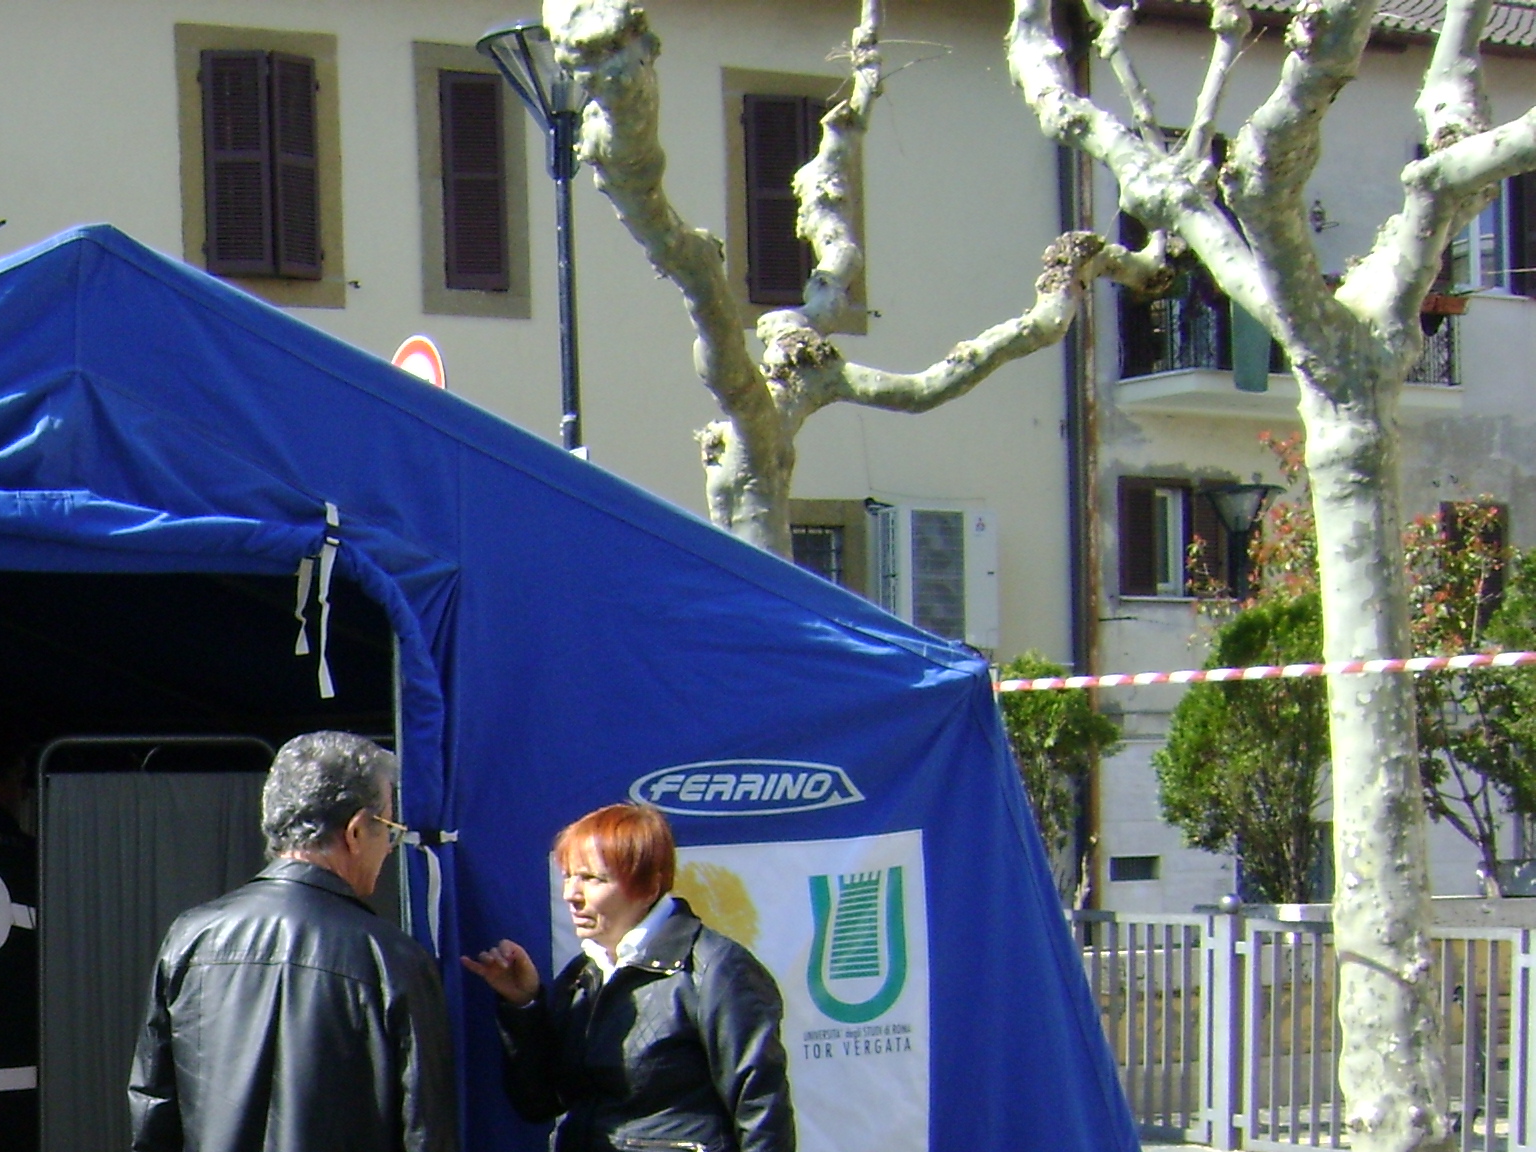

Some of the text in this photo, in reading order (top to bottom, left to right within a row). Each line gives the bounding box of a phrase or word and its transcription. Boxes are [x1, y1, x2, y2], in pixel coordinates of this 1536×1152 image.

[650, 772, 832, 802] FERRINO
[804, 1037, 912, 1060] TOR VERGATA
